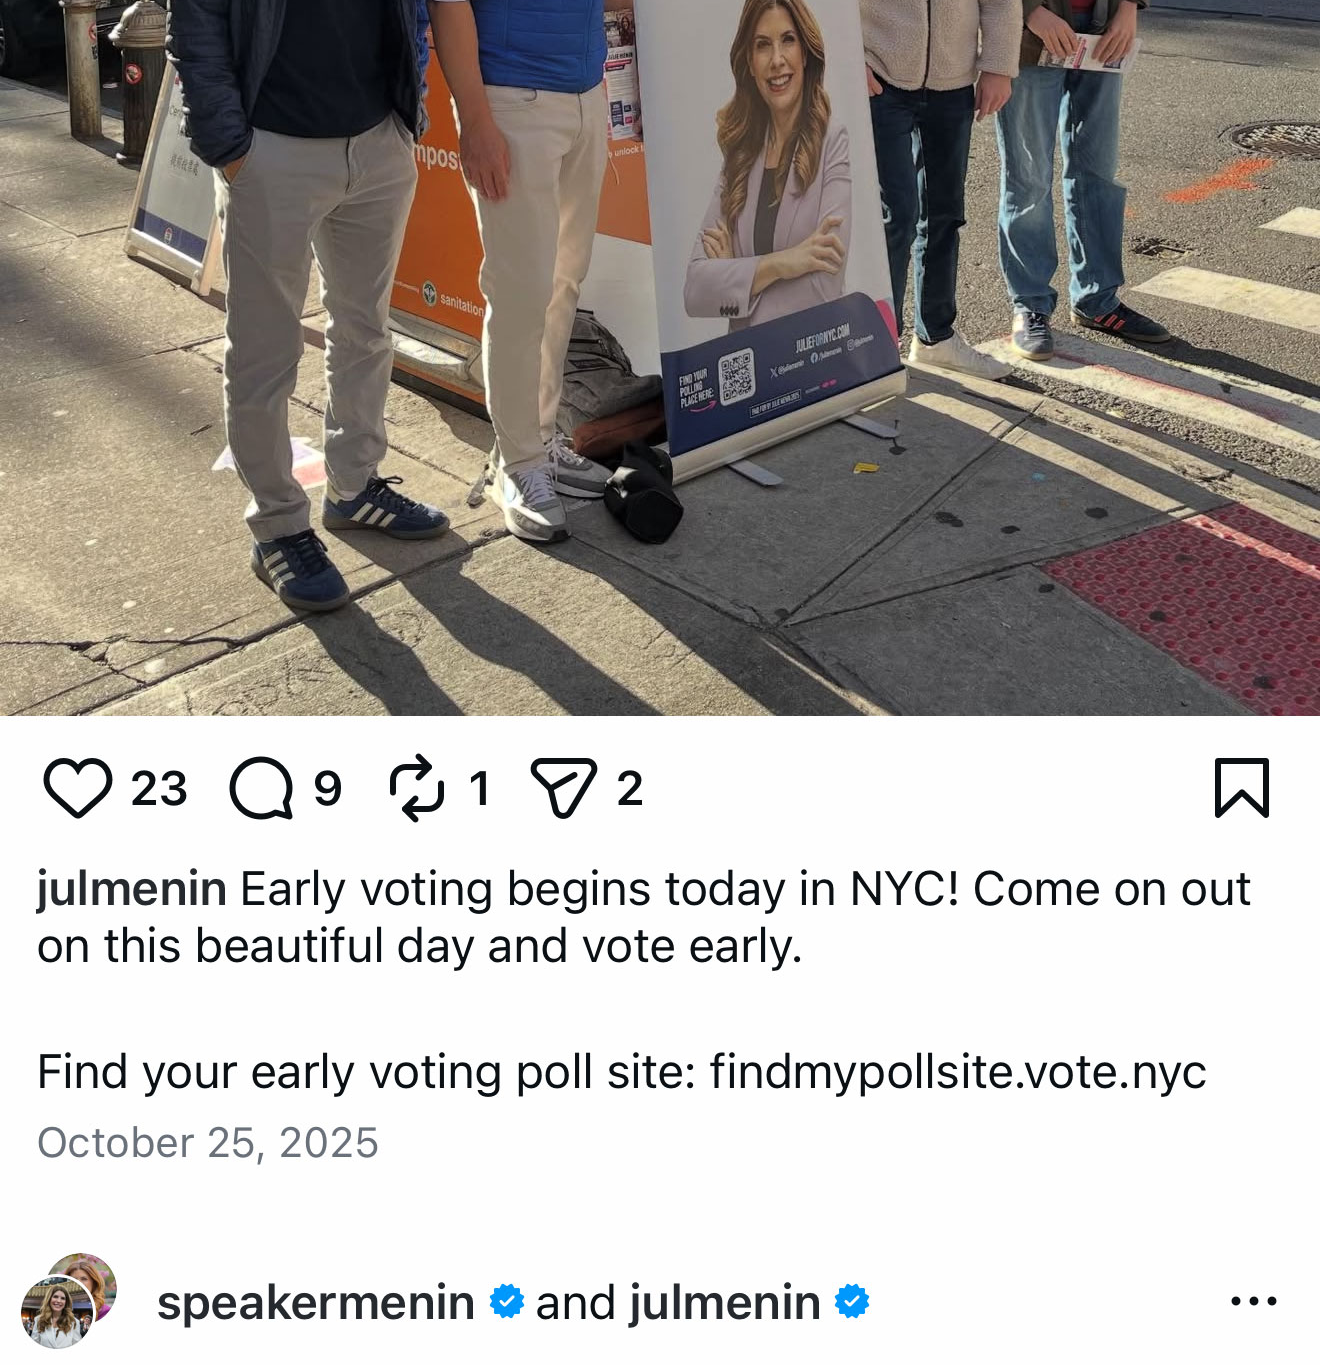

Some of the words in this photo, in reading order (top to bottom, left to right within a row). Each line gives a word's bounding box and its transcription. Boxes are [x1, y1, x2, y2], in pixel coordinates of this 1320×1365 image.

[414, 144, 460, 171] mpos
[614, 145, 639, 157] unlock
[440, 292, 485, 317] sanitation
[796, 323, 850, 353] JULIEFORNYC.COM
[679, 373, 693, 387] FIND
[693, 368, 708, 381] YOUR
[680, 380, 703, 397] POLLING
[680, 393, 698, 409] PLACE
[698, 387, 714, 402] HERE:
